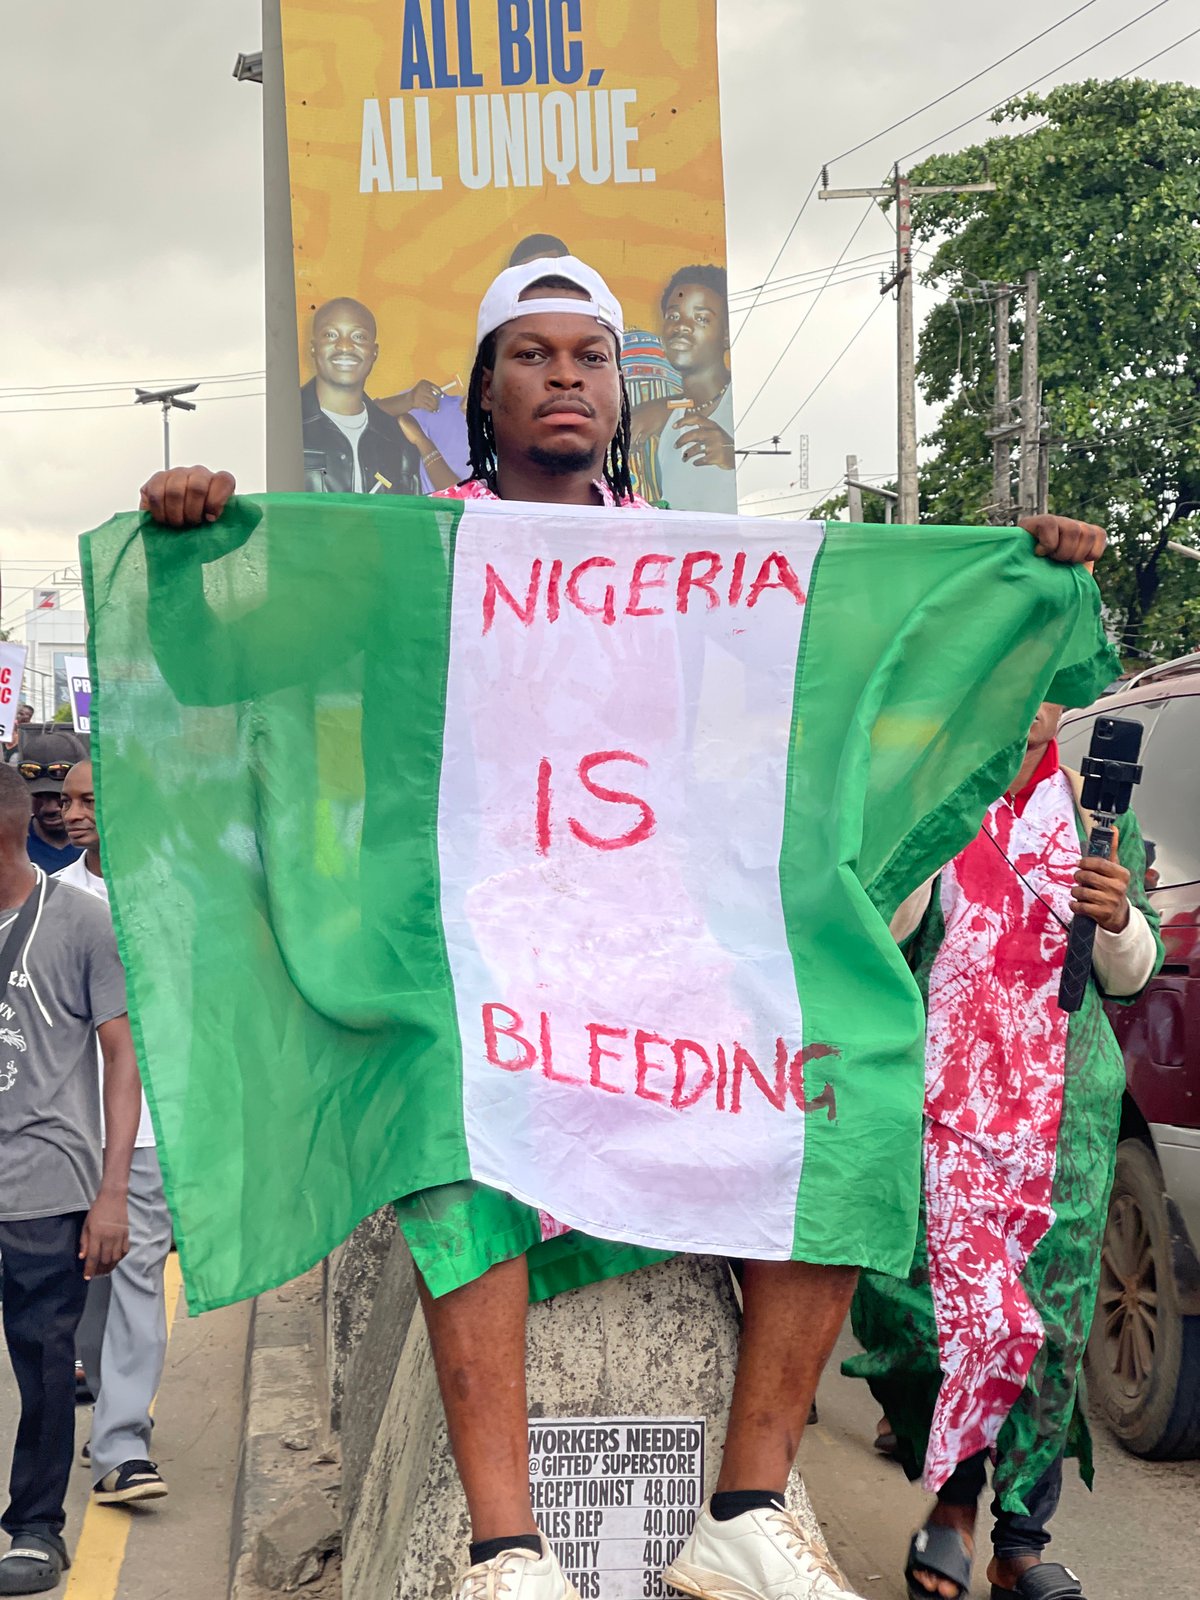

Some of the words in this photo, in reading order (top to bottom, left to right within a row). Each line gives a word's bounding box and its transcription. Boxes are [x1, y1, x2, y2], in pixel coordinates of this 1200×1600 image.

[400, 0, 483, 90] ALL
[498, 0, 605, 86] BIC,
[359, 97, 443, 193] ALL
[456, 89, 656, 189] UNIQUE.
[482, 550, 807, 636] NIGERIA
[535, 750, 656, 858] IS
[482, 1002, 842, 1121] BLEEDING
[528, 1429, 619, 1454] WORKERS
[626, 1428, 699, 1453] NEEDED
[602, 1454, 695, 1475] SUPERSTORE
[643, 1479, 696, 1508] 48,000
[536, 1511, 570, 1538] ALES
[575, 1510, 603, 1537] REP
[643, 1509, 695, 1539] 40,000
[549, 1541, 600, 1568] URITY
